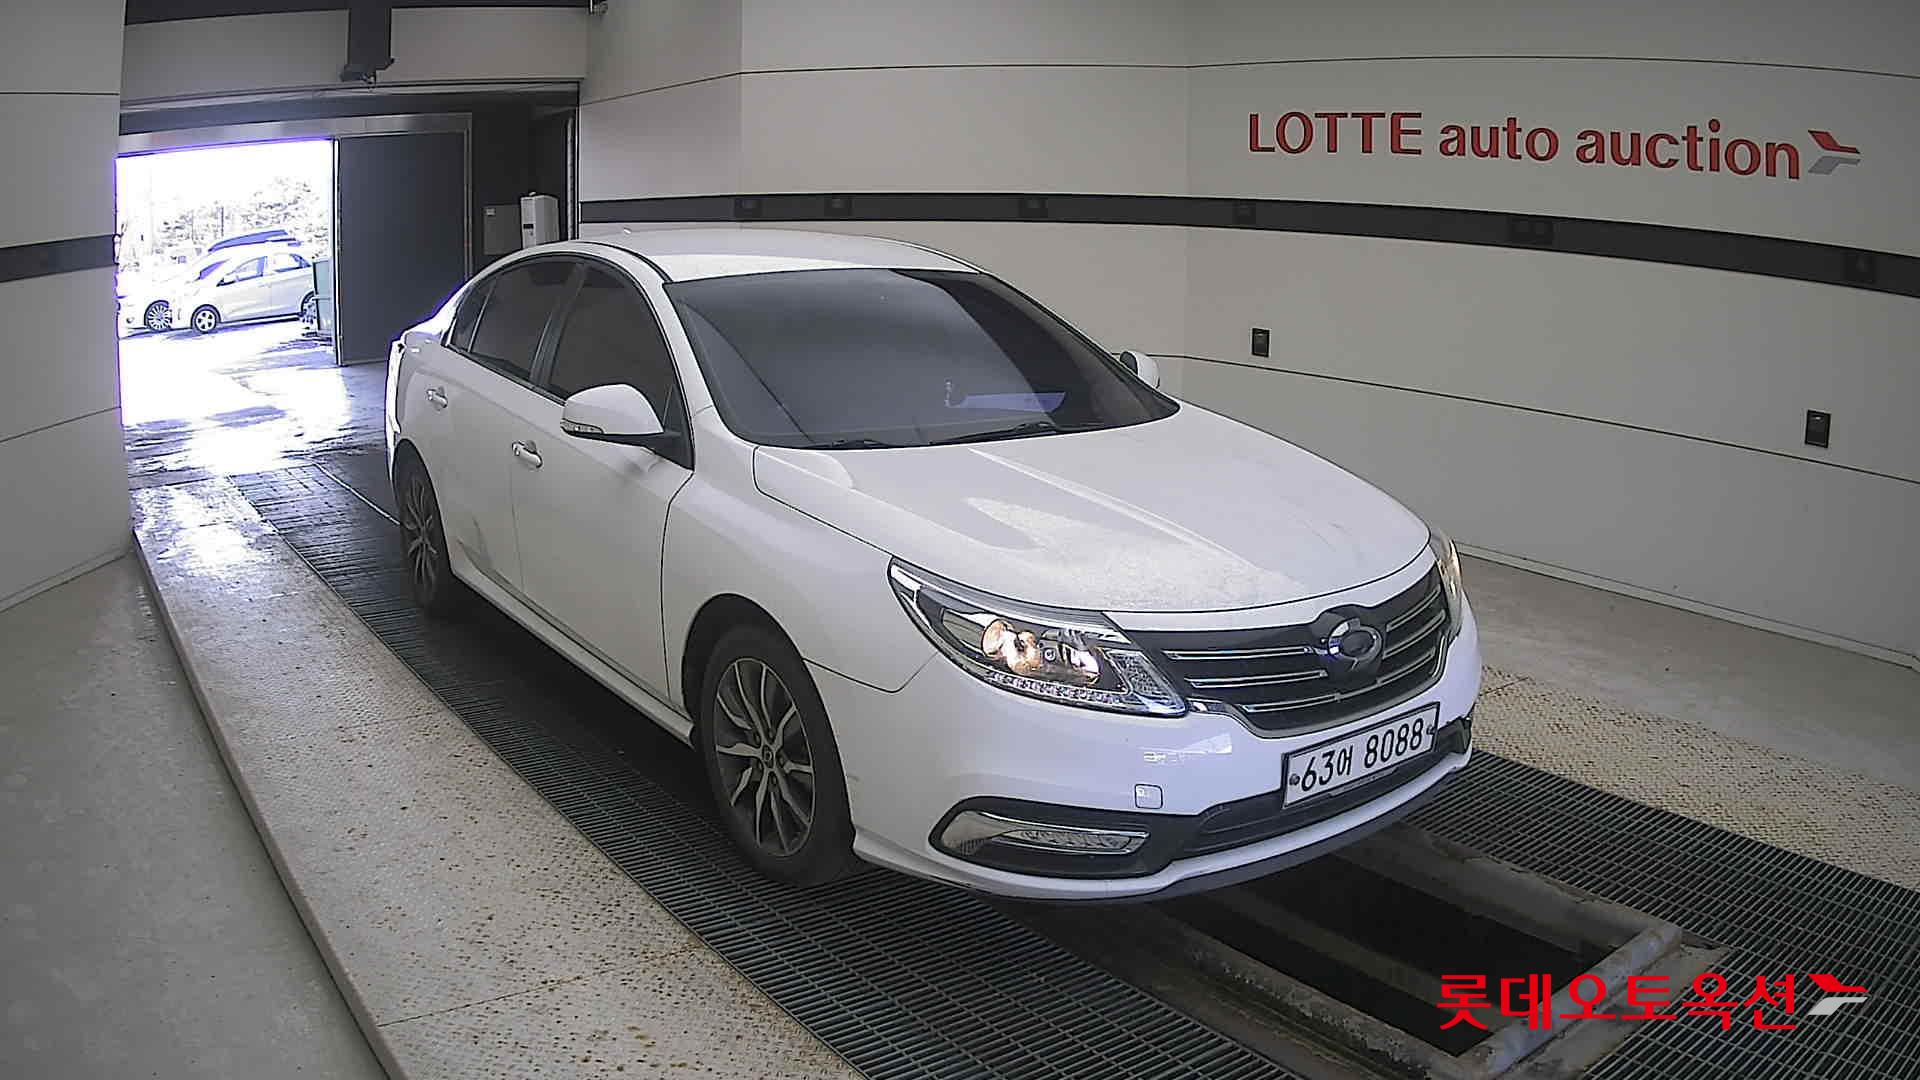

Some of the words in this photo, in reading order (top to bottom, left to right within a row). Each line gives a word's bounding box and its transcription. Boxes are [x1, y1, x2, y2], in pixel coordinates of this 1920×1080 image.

[1248, 112, 1422, 155] LOTTE
[1439, 116, 1560, 162] auto
[1575, 119, 1800, 180] auction
[1301, 744, 1354, 792] 63어
[1364, 717, 1424, 768] 8088
